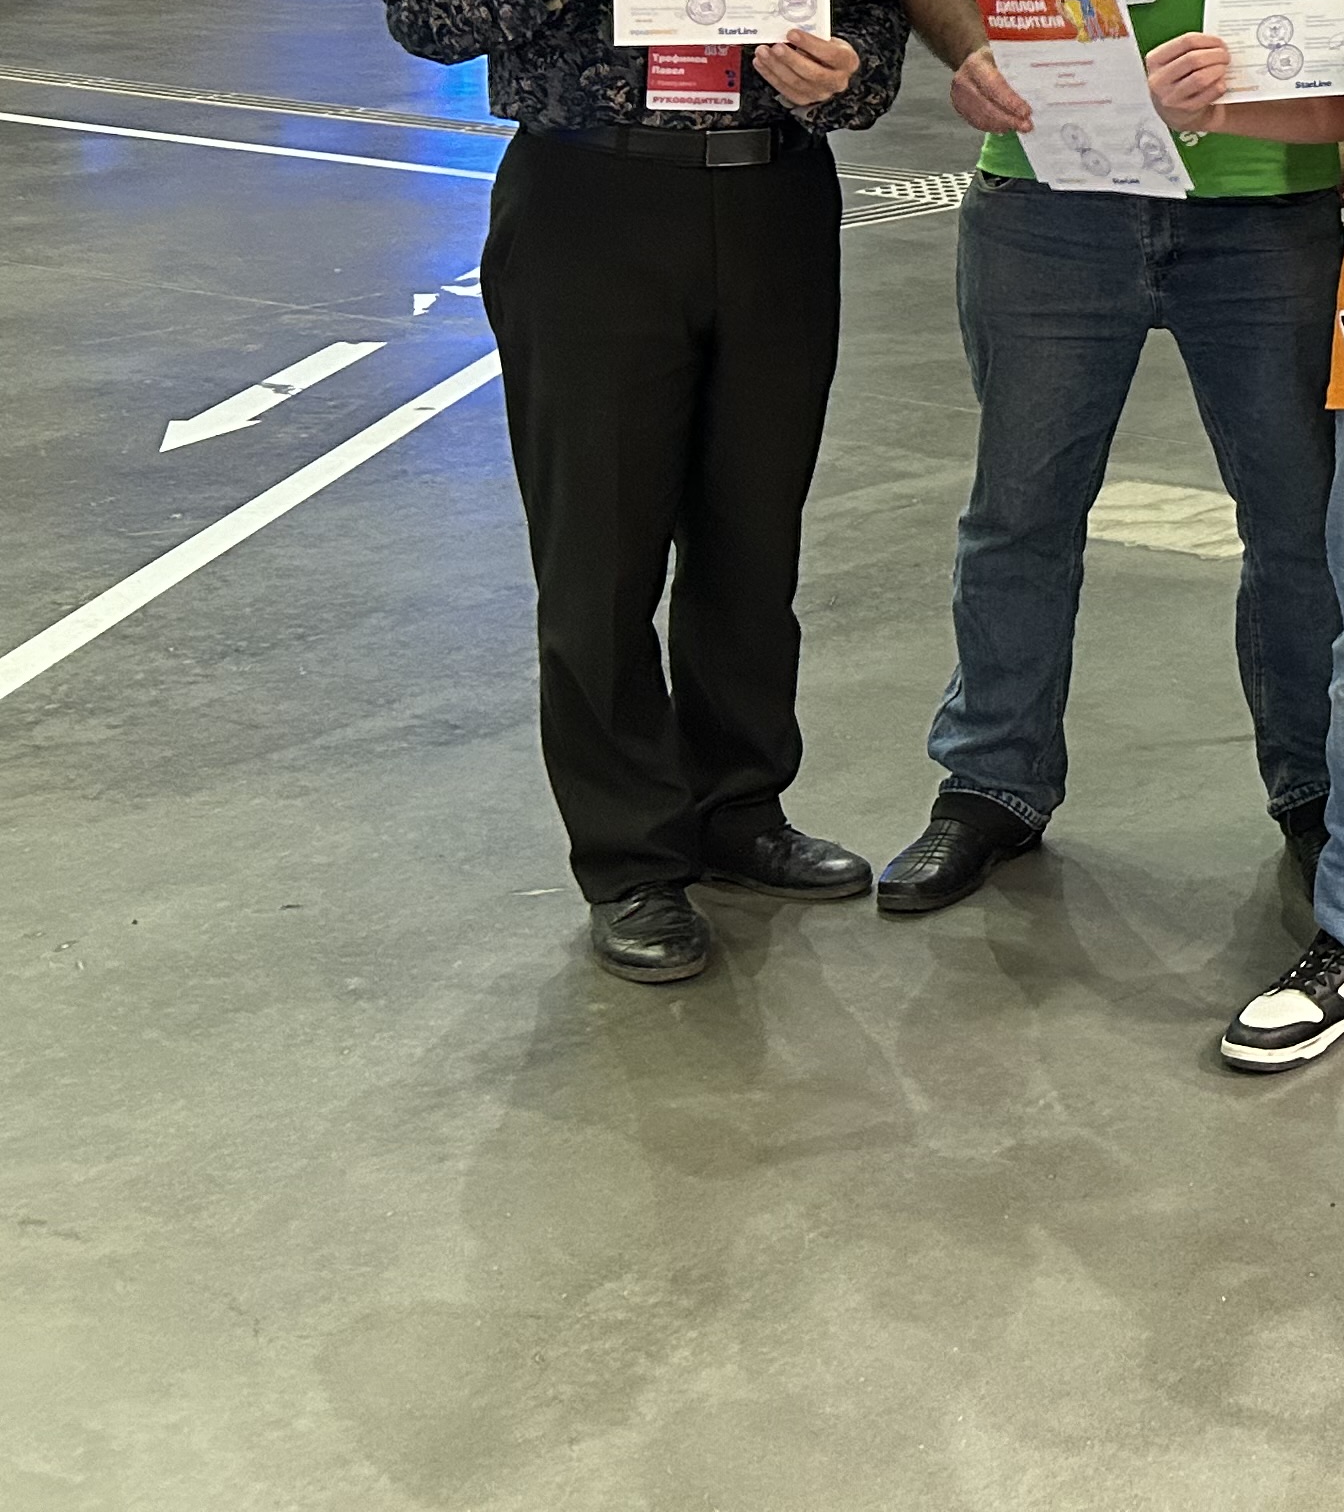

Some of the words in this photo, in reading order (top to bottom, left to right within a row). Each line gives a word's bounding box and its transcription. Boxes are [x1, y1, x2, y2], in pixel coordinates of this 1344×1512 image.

[995, 0, 1047, 13] ДИПЛОМ
[988, 15, 1066, 29] ПОБЕДИТЕЛЯ
[717, 27, 758, 35] StarLine
[1295, 80, 1332, 89] StarLine
[652, 96, 734, 105] РУКОВОДИТЕЛЬ
